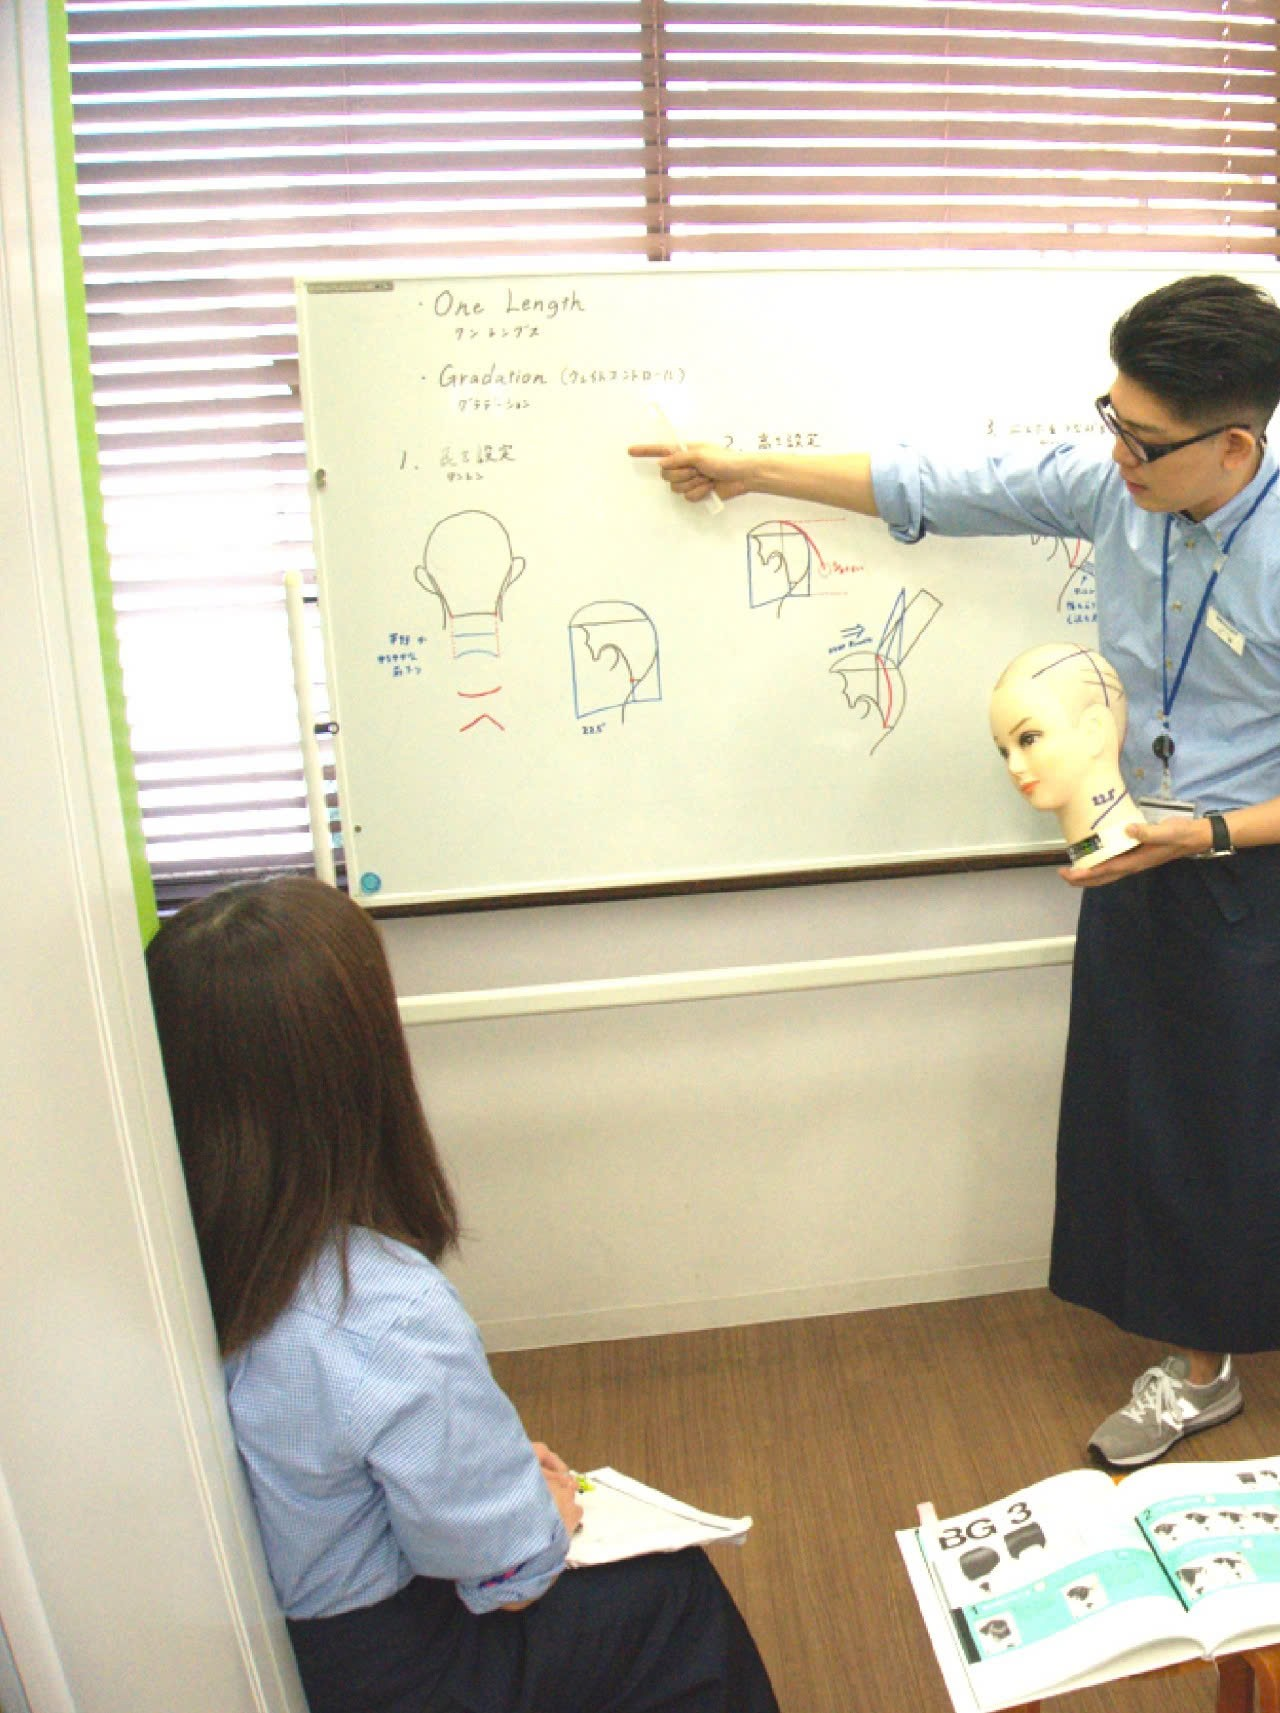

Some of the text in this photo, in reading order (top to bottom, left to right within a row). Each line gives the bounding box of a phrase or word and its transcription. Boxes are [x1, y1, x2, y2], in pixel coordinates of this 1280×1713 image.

[435, 288, 585, 319] One Length
[439, 362, 548, 387] Gradation
[1007, 1501, 1032, 1524] 3
